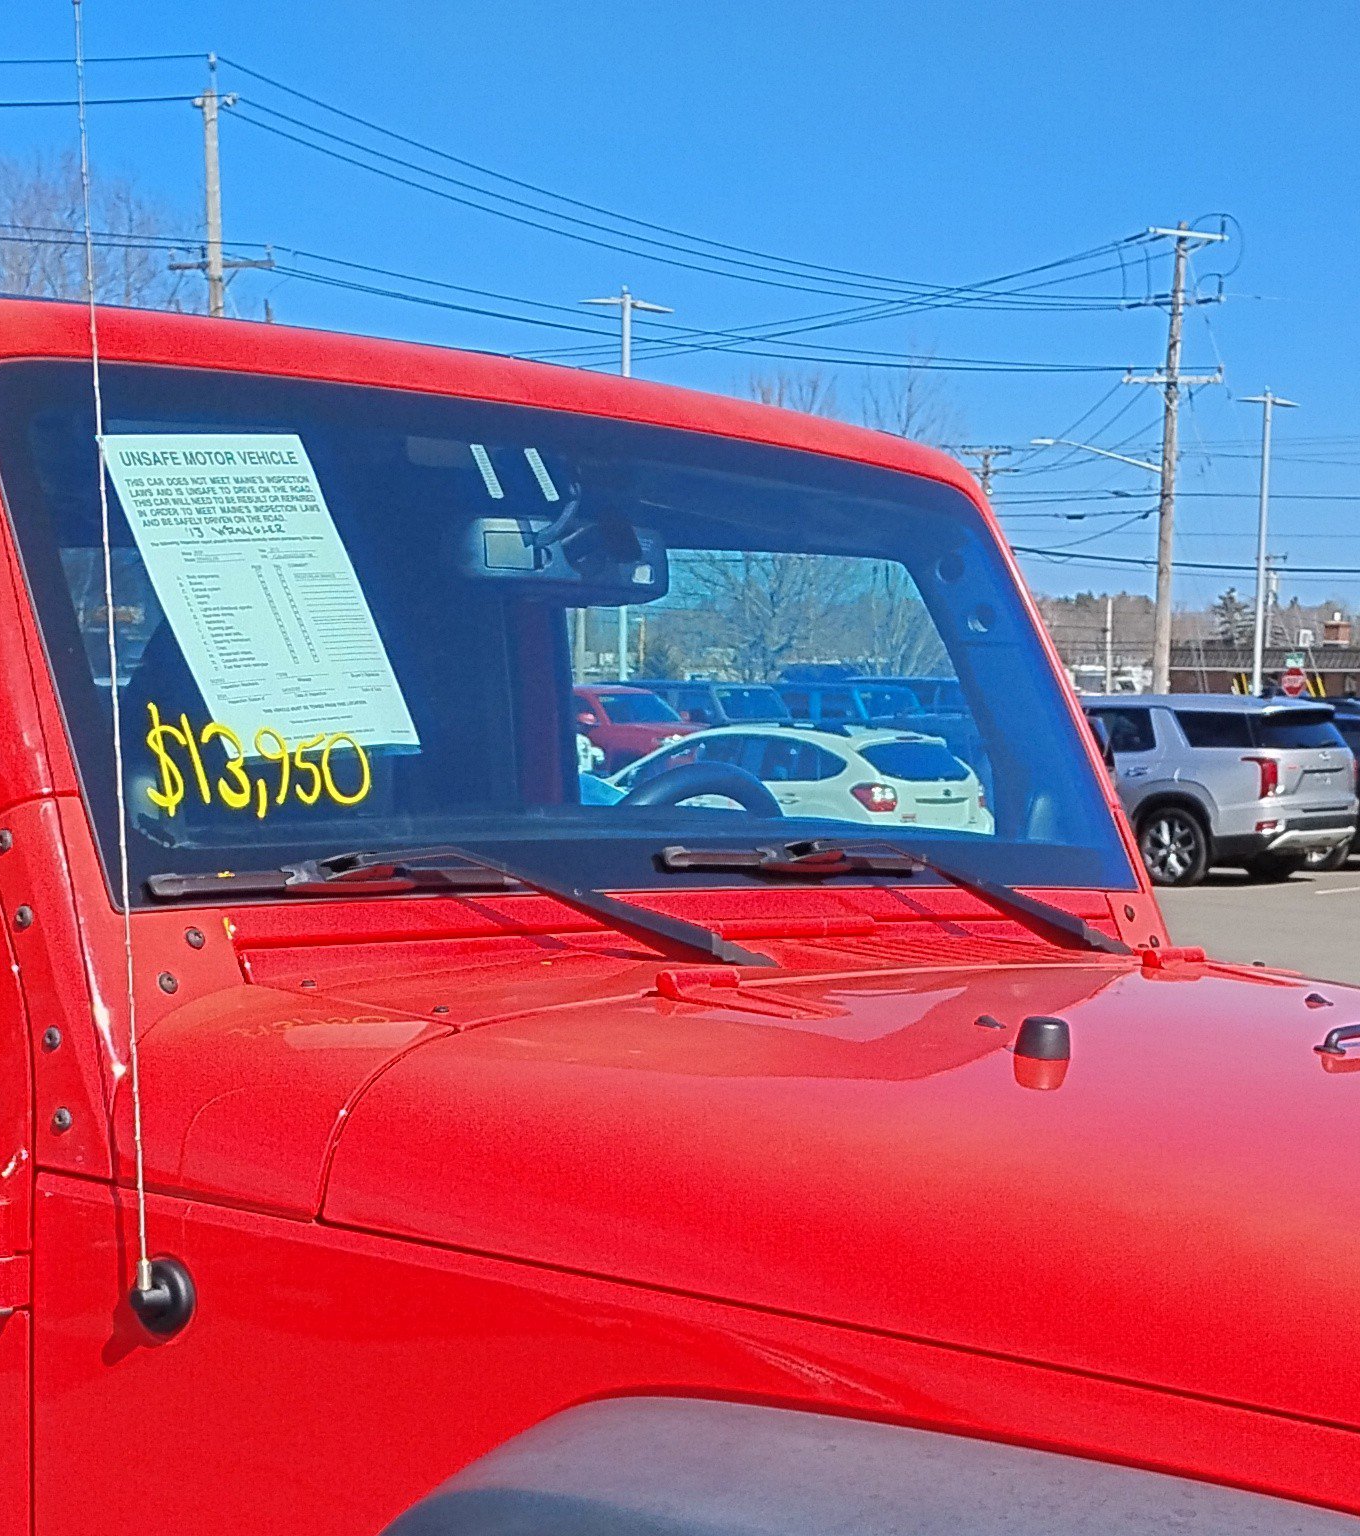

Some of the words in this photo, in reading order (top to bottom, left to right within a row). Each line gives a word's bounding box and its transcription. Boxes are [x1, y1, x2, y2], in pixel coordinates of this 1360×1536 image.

[119, 451, 179, 466] UNSAFE
[183, 451, 237, 466] MOTOR
[239, 451, 299, 465] VEHICLE
[211, 524, 286, 536] WRANGLER
[146, 701, 371, 820] $13,950
